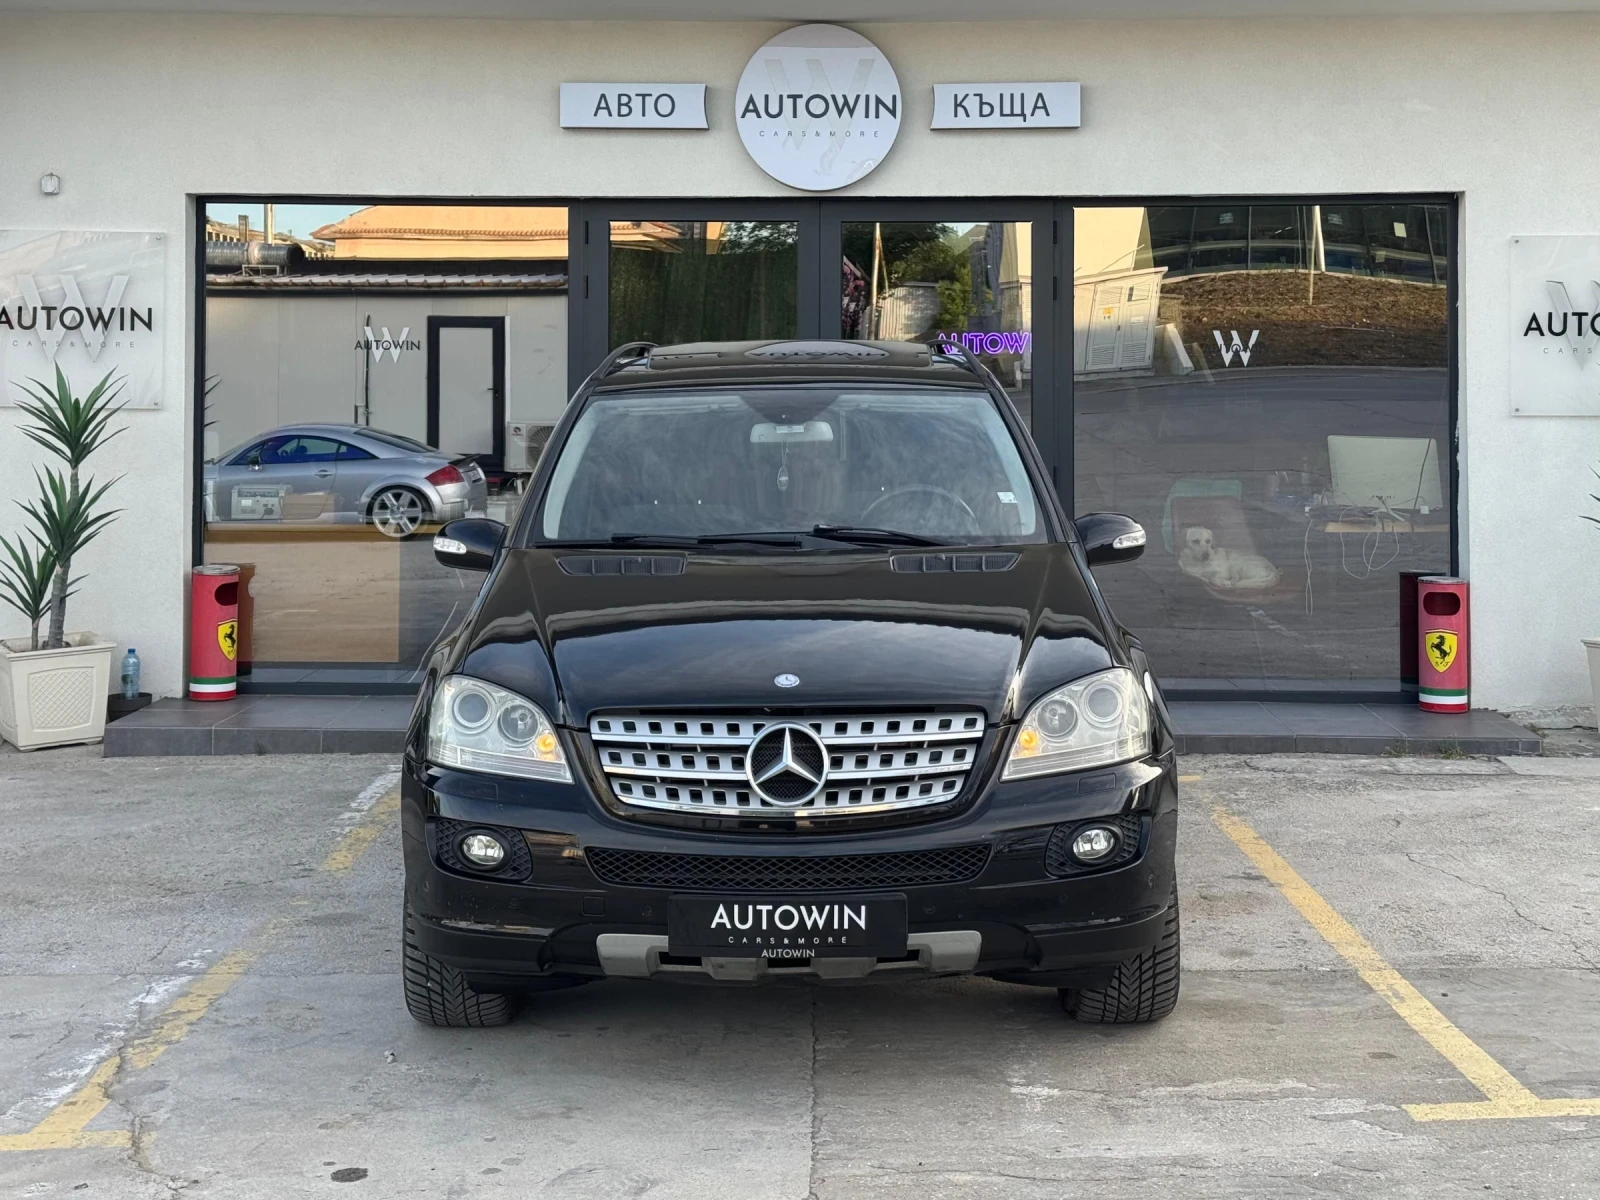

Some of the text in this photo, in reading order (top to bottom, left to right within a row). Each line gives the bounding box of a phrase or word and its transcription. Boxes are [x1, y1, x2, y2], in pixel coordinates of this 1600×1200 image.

[593, 93, 676, 118] АВТО
[740, 93, 897, 119] AUTOWIN
[953, 92, 1050, 122] КЪЩА
[759, 130, 879, 138] CARS&MORE
[0, 305, 152, 333] AUTOWIN
[12, 340, 135, 349] CARS&MORE
[354, 339, 421, 351] AUTOWIN
[710, 903, 866, 931] AUTOWIN
[728, 936, 847, 945] CARS&MORE
[761, 948, 815, 958] AUTOWIN
